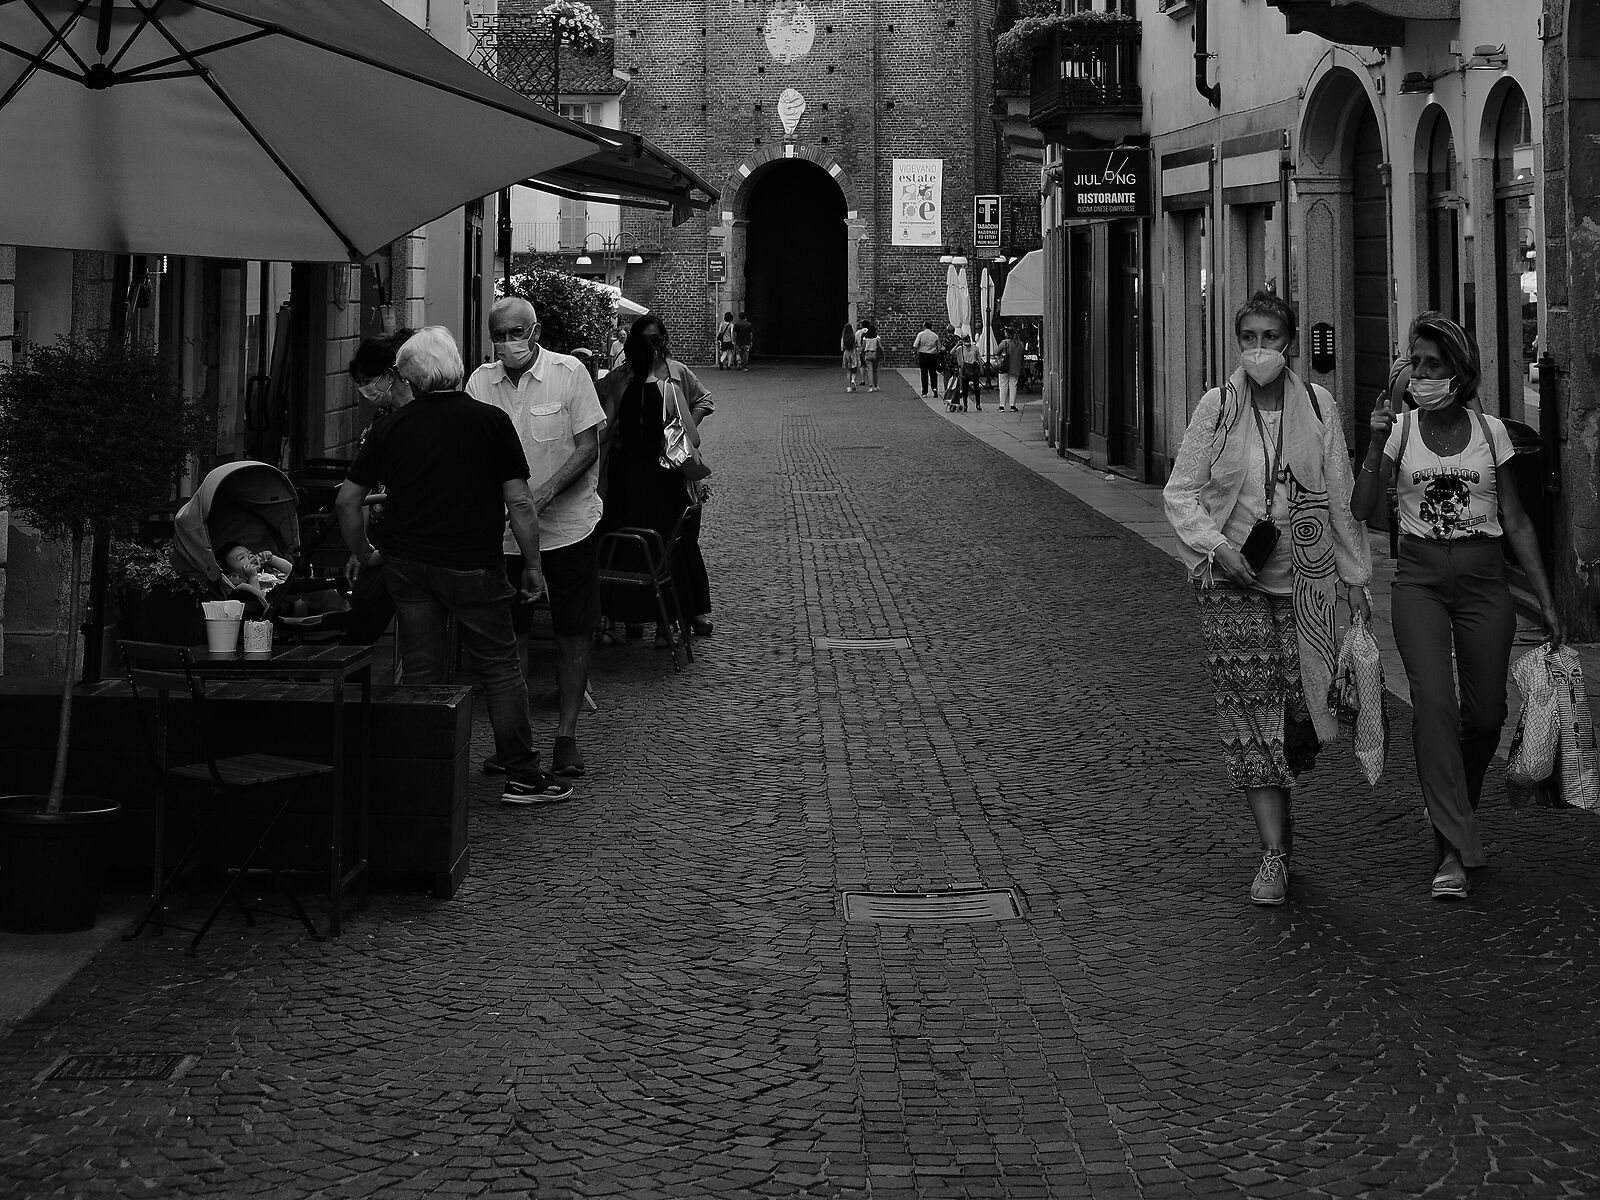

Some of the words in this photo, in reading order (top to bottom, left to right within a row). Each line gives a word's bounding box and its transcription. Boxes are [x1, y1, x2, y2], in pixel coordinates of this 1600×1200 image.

[899, 174, 936, 182] estate
[1077, 193, 1135, 203] RISTORANTE
[979, 200, 997, 222] T
